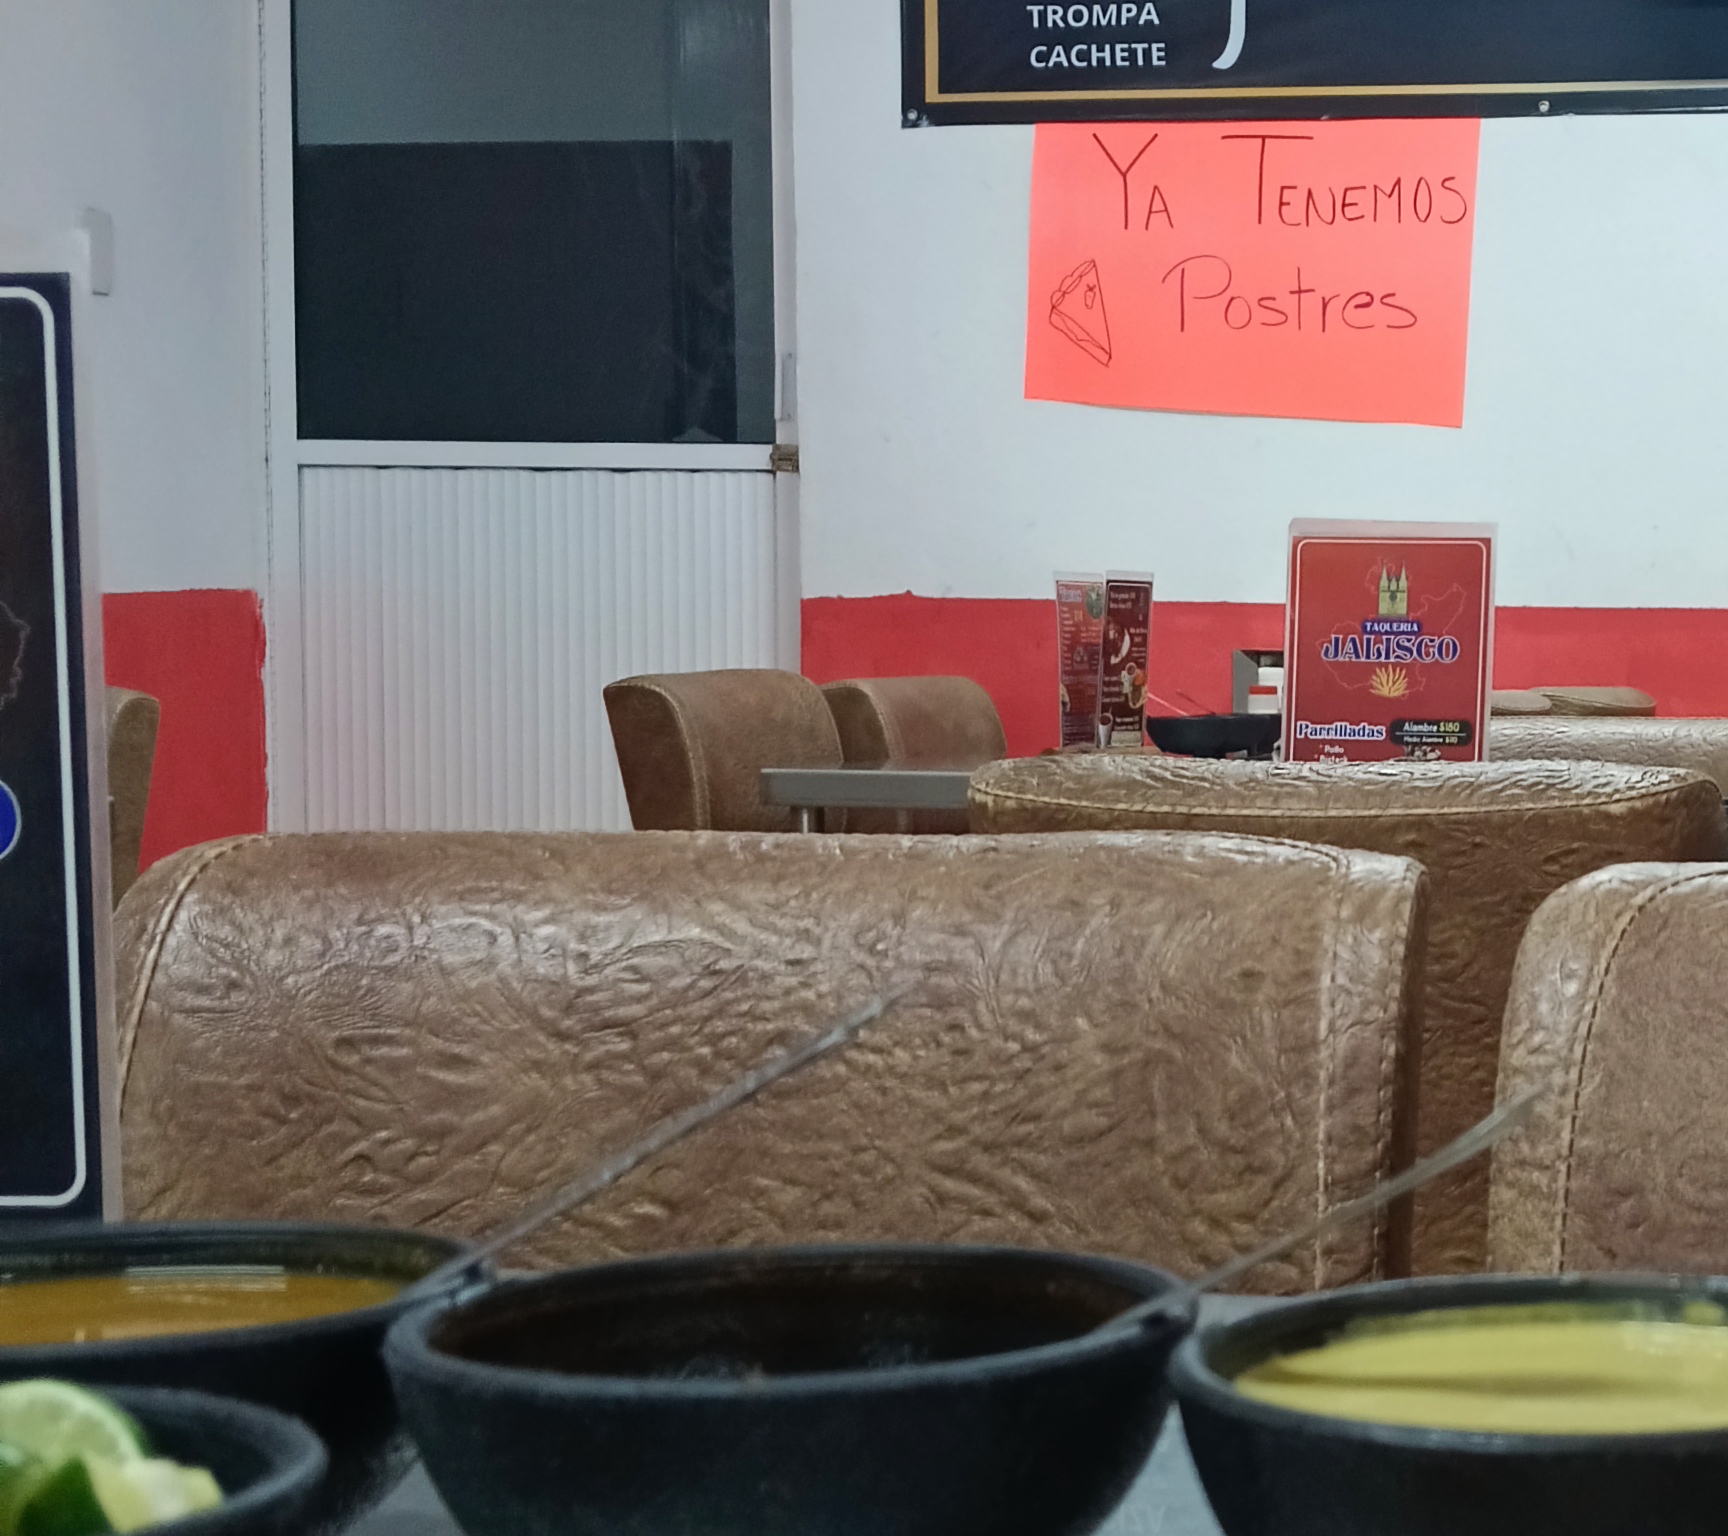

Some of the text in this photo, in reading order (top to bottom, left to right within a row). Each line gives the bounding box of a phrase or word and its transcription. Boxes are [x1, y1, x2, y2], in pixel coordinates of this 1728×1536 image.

[1026, 1, 1161, 30] TROMPA
[1028, 42, 1167, 69] CACHETE
[1092, 132, 1468, 231] YA TENEMOS
[1161, 254, 1418, 333] Postres
[1364, 622, 1419, 633] TAQUERIA
[1321, 634, 1460, 664] JALISCO
[1296, 720, 1386, 741] Parrilladas
[1402, 722, 1438, 732] Alambre
